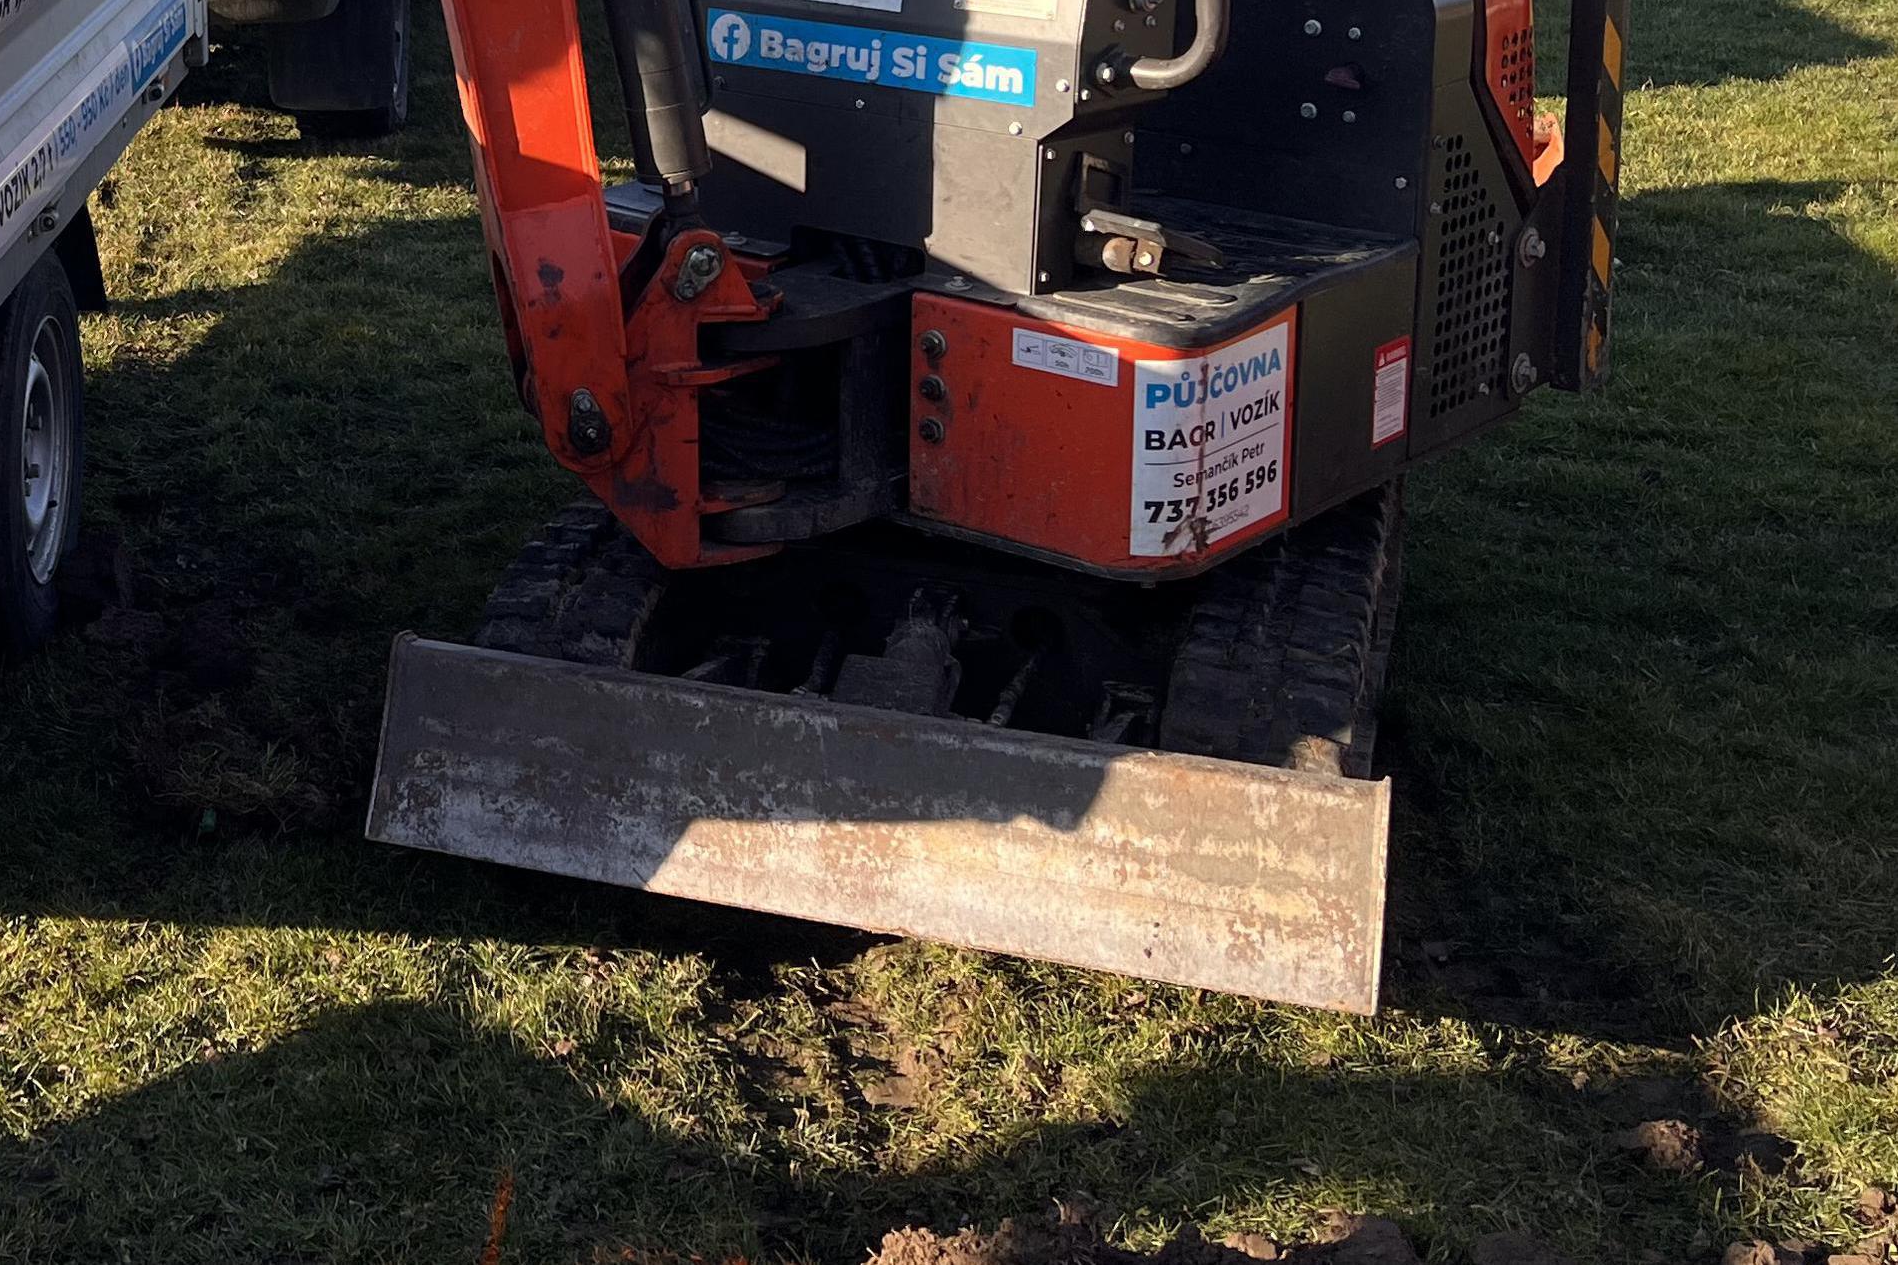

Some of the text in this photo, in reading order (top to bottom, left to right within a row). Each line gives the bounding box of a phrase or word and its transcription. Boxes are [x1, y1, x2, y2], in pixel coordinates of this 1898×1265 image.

[760, 29, 882, 80] Bagruj
[891, 44, 927, 80] Si
[937, 53, 1023, 95] Sám
[1146, 348, 1281, 409] PŮJČOVNA
[1145, 420, 1215, 451] BAGR
[1230, 389, 1280, 430] VOZÍK
[1241, 442, 1265, 464] Petr
[1144, 460, 1277, 524] 737 356 596
